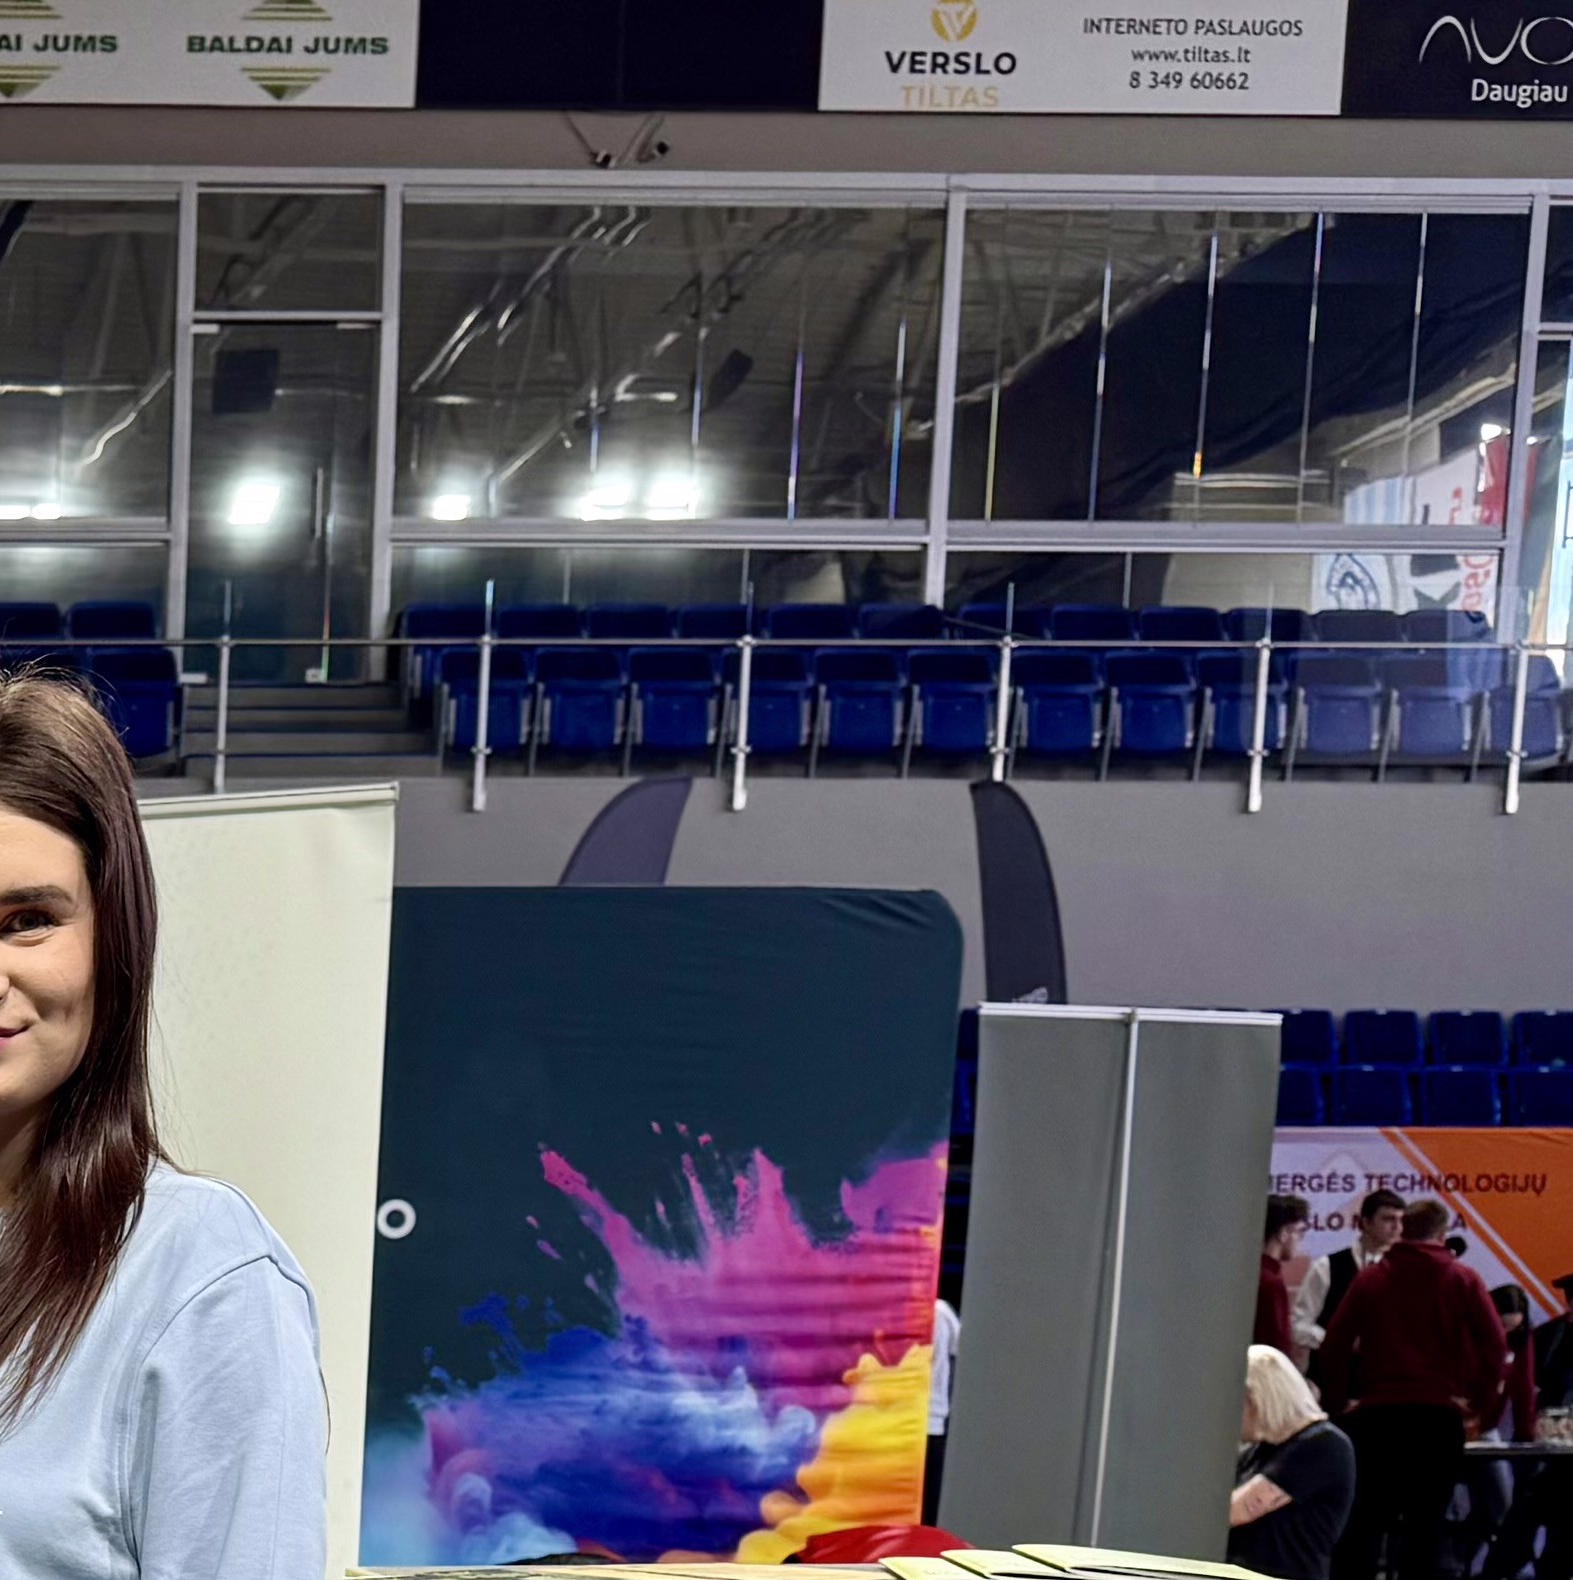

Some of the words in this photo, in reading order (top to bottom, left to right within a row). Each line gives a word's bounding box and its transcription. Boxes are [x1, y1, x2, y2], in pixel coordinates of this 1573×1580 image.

[1083, 17, 1188, 35] INTERNETO
[1194, 18, 1304, 37] PASLAUGOS
[33, 34, 119, 53] JUMS
[186, 35, 293, 54] BALDAI
[303, 36, 389, 55] JUMS
[884, 50, 1018, 75] VERSLO
[1130, 45, 1252, 63] www.tiltas.lt
[1129, 71, 1141, 89] 8
[1148, 71, 1183, 89] 349
[1190, 72, 1250, 90] 60662
[900, 85, 1000, 108] TILTAS
[1471, 78, 1569, 108] Daugiau
[1364, 1173, 1548, 1196] TECHNOLOGIJŲ
